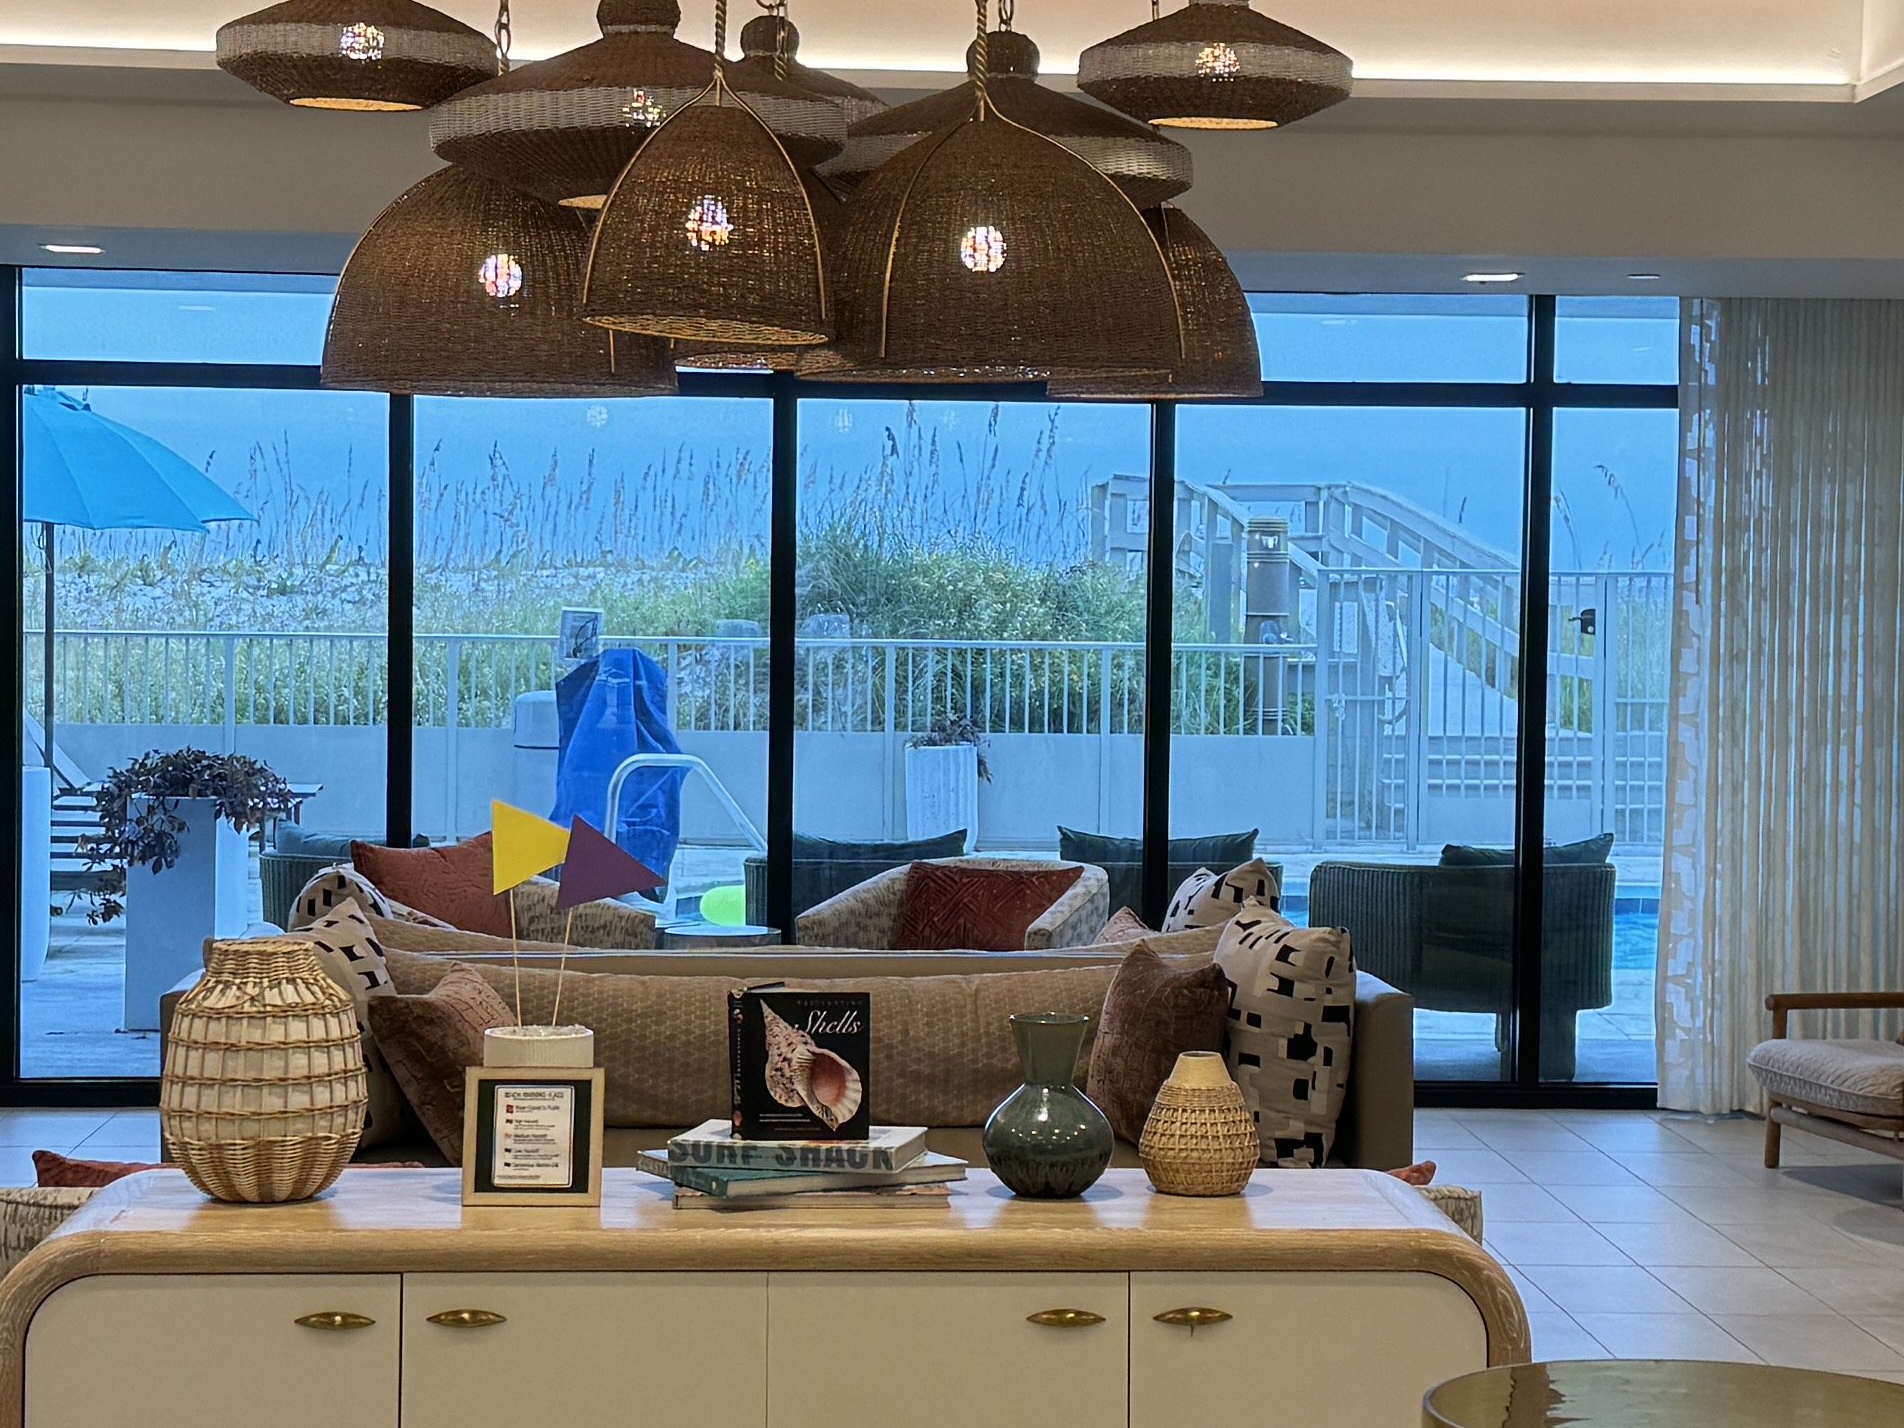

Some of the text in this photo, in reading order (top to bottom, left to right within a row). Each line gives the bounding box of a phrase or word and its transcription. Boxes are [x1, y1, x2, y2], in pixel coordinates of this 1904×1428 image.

[805, 1010, 861, 1034] Shells
[669, 1143, 894, 1171] SURF SHACK
